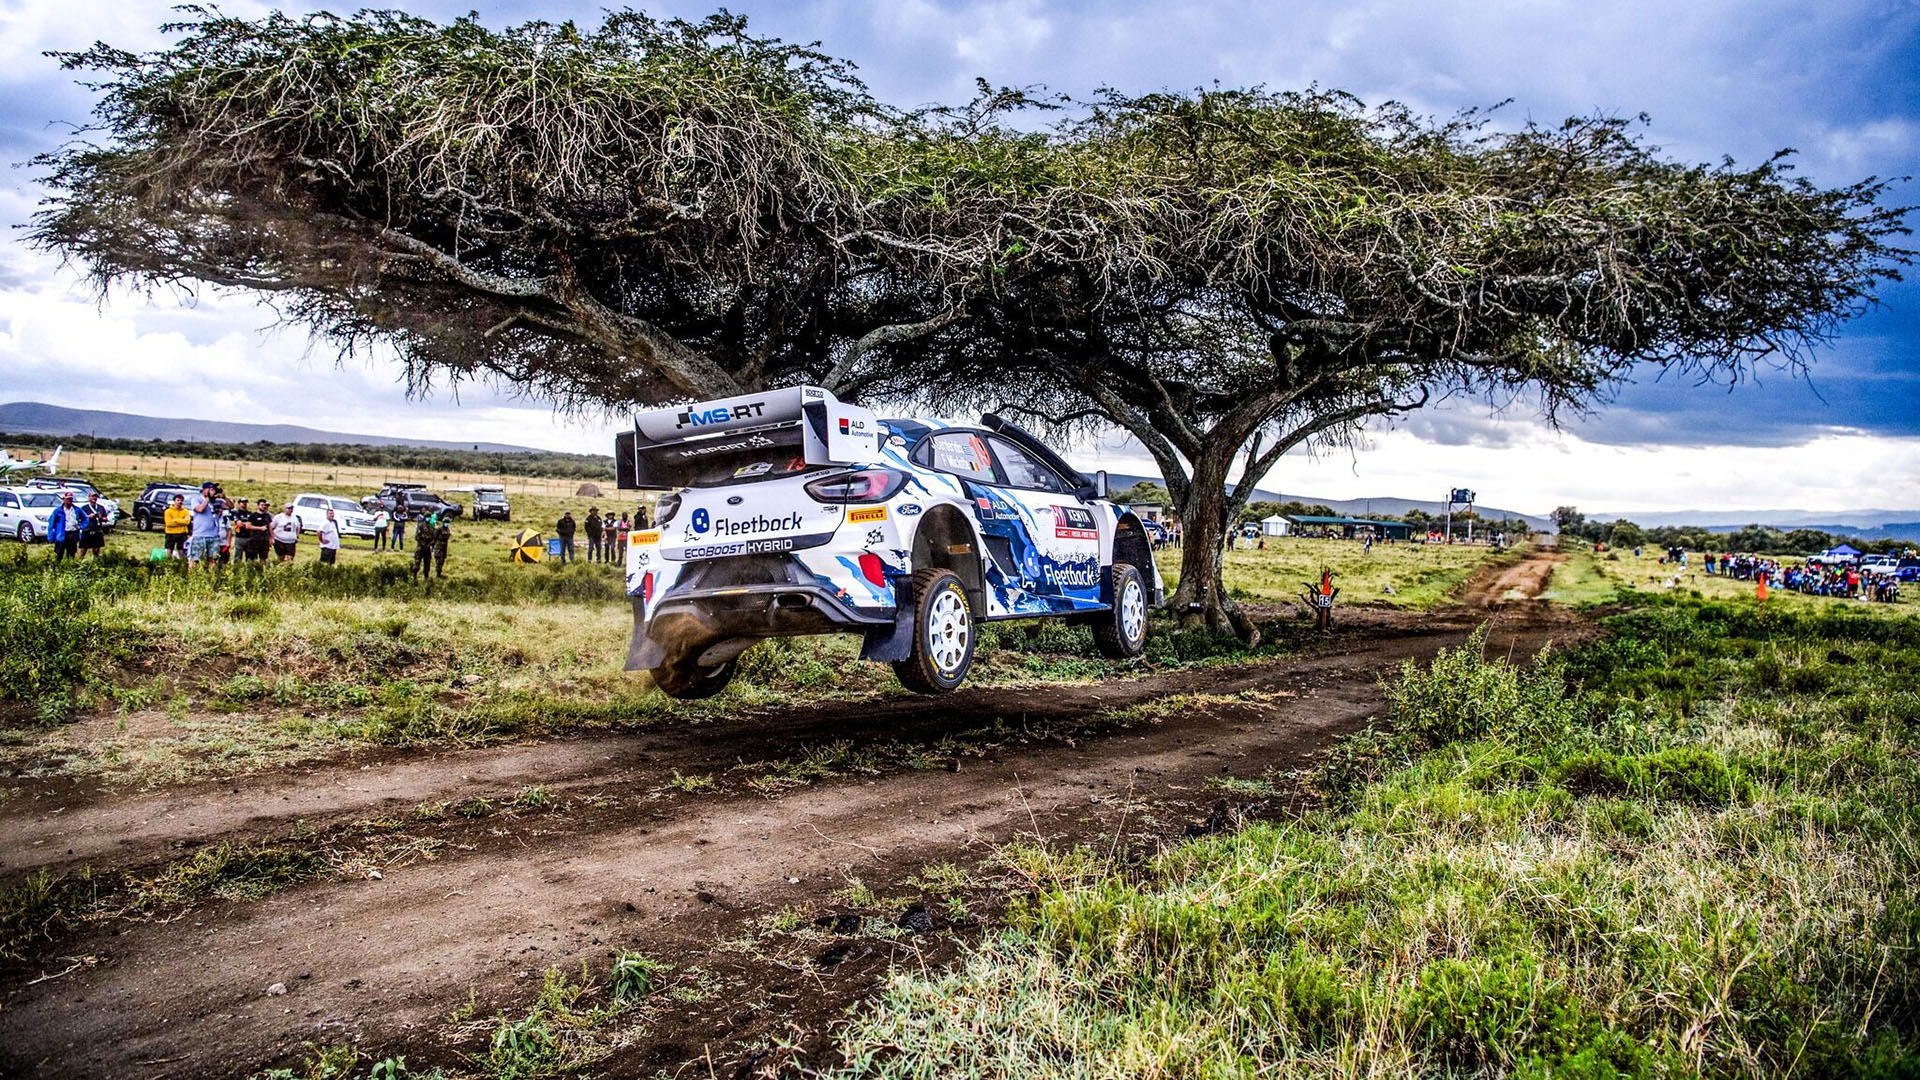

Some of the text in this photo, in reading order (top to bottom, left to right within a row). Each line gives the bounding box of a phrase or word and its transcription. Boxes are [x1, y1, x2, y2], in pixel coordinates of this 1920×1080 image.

[690, 402, 765, 427] MS-RT
[851, 421, 865, 429] ALD
[680, 441, 748, 458] M-SPORT
[901, 505, 919, 515] Ford
[992, 501, 1008, 510] ALD
[850, 509, 884, 521] PIRELLI
[1066, 509, 1091, 523] KENYA
[714, 512, 803, 537] Fleetback
[633, 533, 659, 544] PIRELLI
[747, 539, 793, 554] HYBRID
[1044, 564, 1094, 586] Fleetback
[1320, 596, 1330, 606] 15
